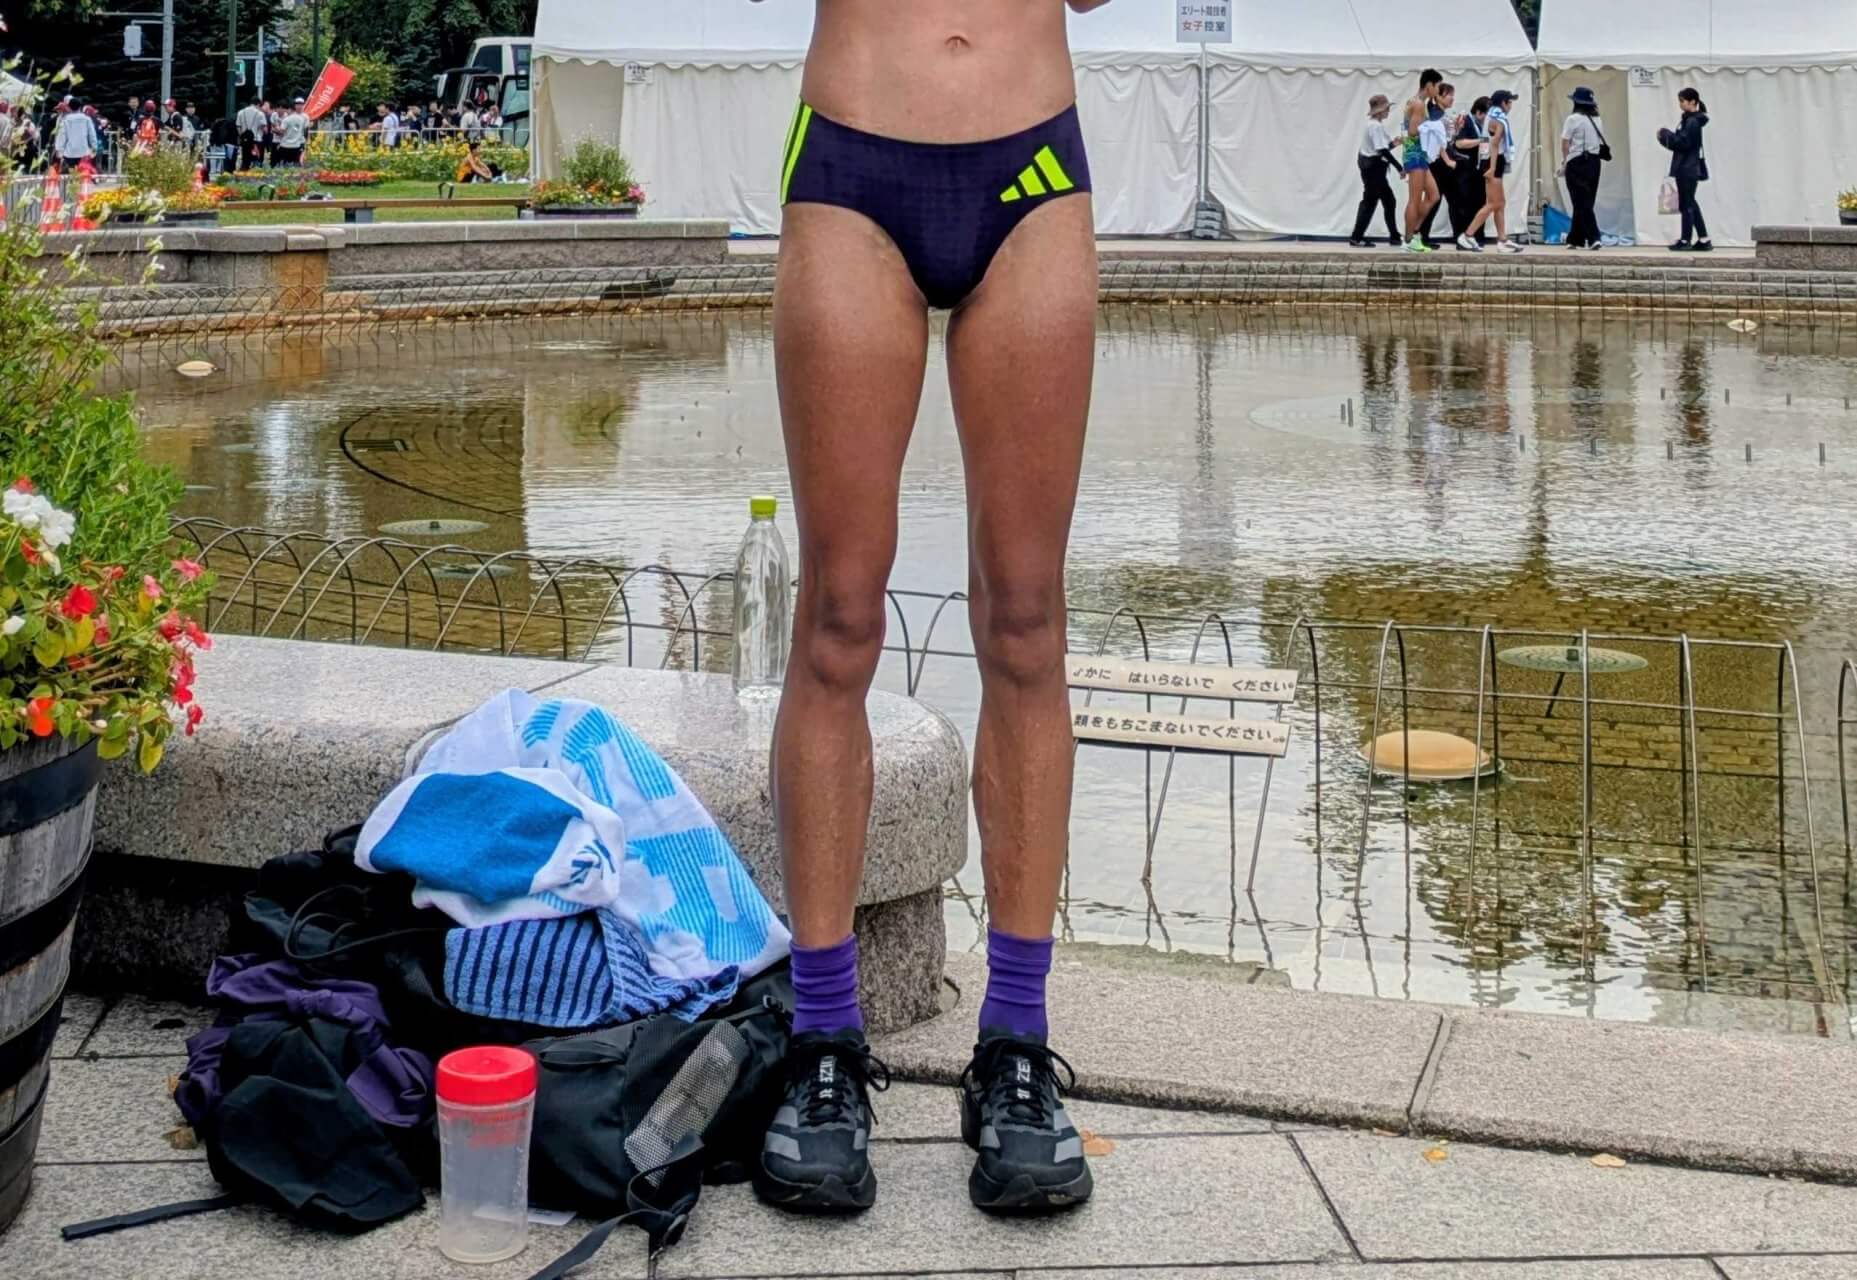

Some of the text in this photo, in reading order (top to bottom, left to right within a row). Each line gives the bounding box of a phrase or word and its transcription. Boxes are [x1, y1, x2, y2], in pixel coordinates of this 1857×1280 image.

[1128, 671, 1214, 689] はいらないで
